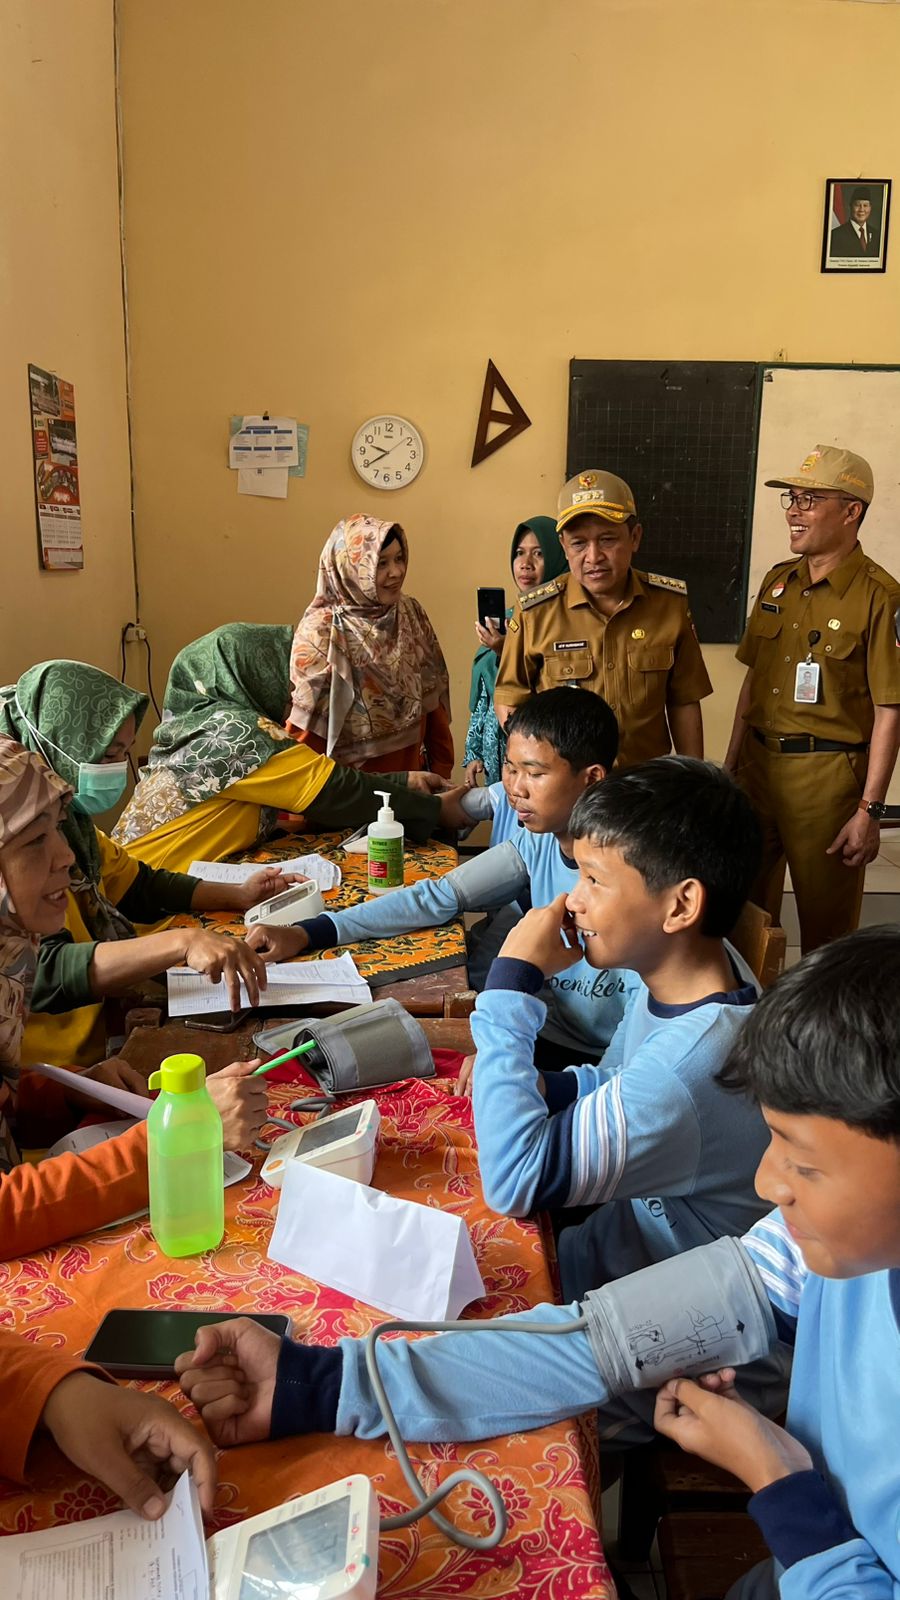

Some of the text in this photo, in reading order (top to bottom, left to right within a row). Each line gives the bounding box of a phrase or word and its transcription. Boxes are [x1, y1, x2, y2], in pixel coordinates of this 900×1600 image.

[374, 426, 381, 435] 11
[385, 423, 394, 432] 12
[365, 435, 374, 444] 10
[406, 437, 413, 446] 2
[359, 446, 366, 455] 9
[409, 450, 416, 459] 3
[363, 459, 370, 468] 8
[405, 463, 411, 471] 4
[373, 469, 379, 478] 7
[383, 474, 390, 482] 6
[395, 471, 402, 480] 5
